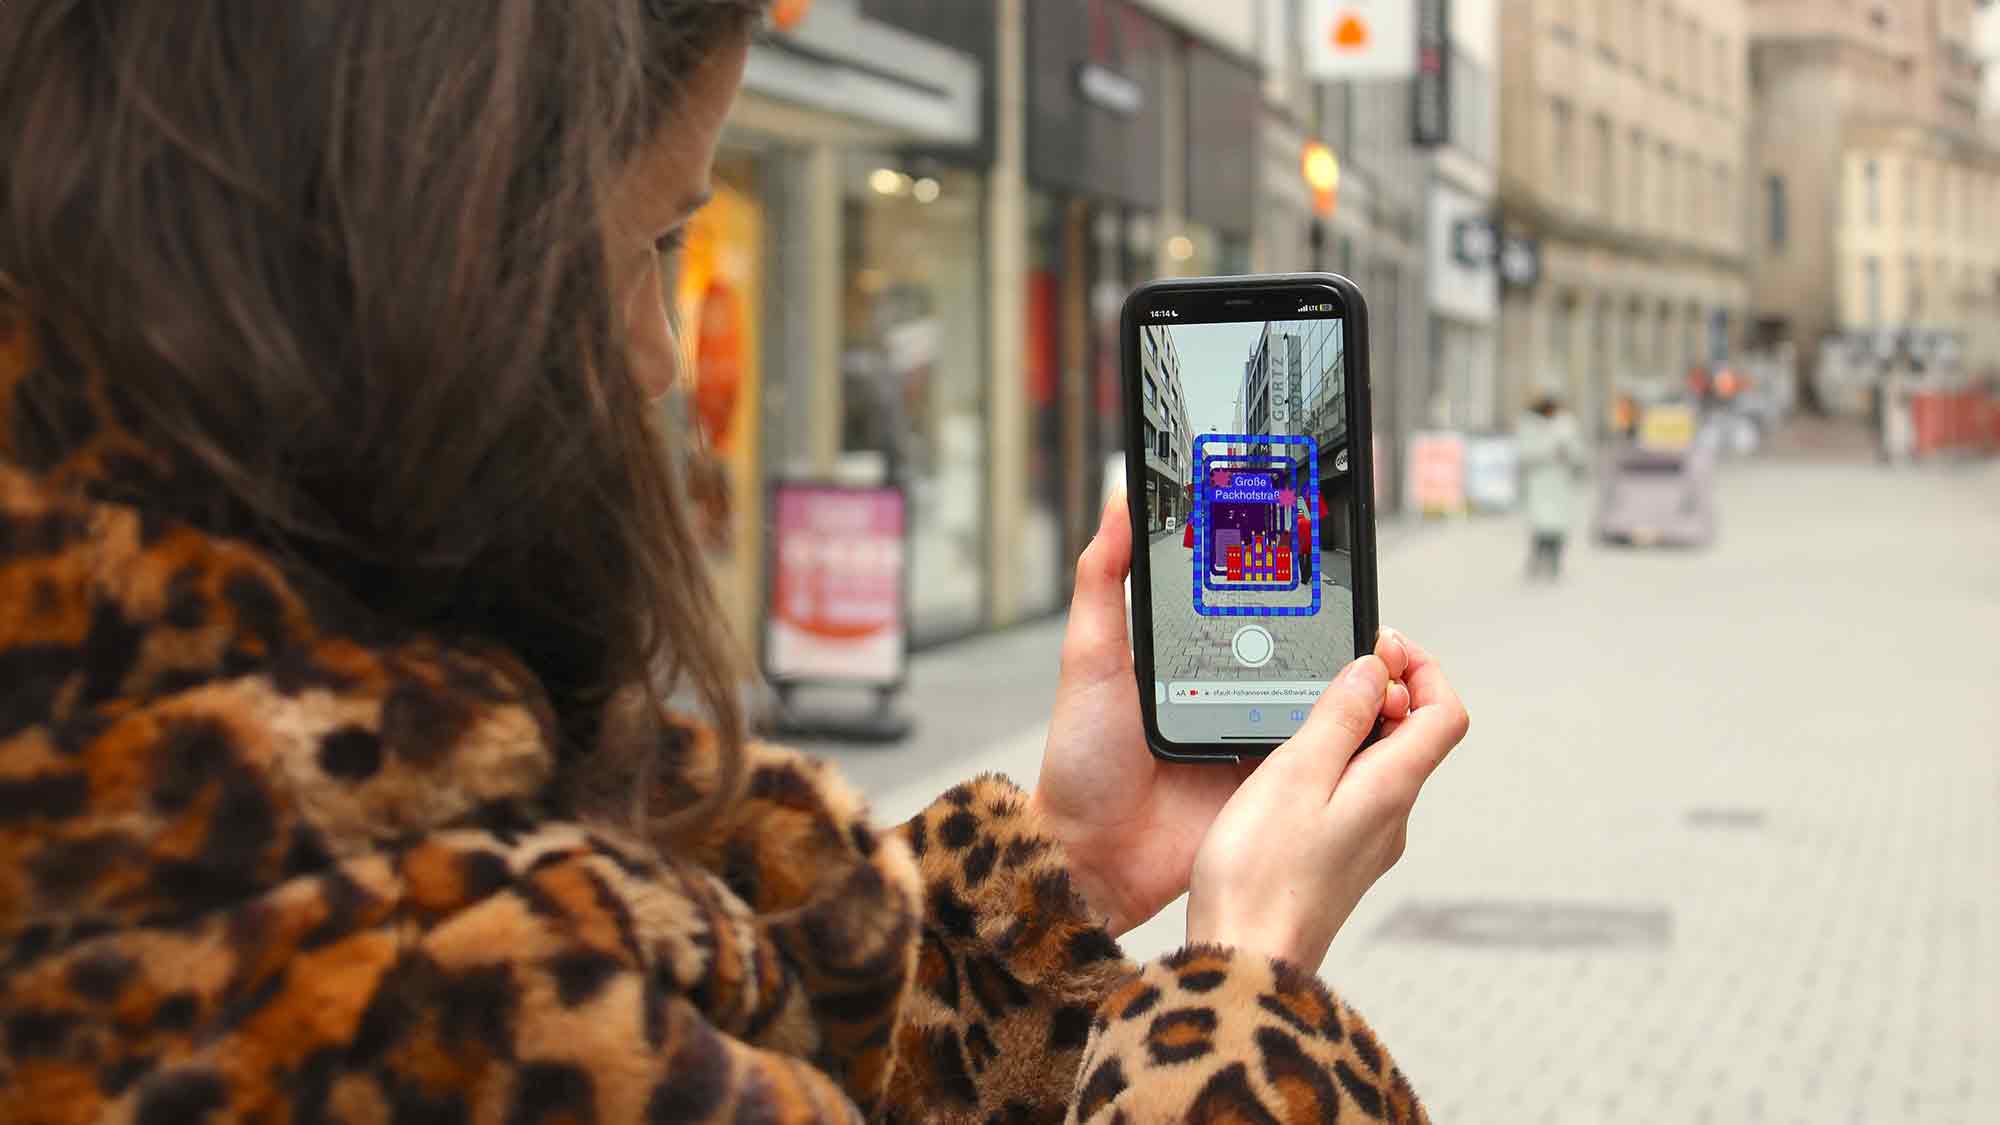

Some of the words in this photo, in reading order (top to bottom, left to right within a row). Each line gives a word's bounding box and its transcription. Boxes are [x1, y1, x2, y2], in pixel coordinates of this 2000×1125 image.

[1150, 310, 1170, 318] 14:14
[1235, 476, 1266, 487] Große
[1215, 489, 1280, 500] Packhofstraß
